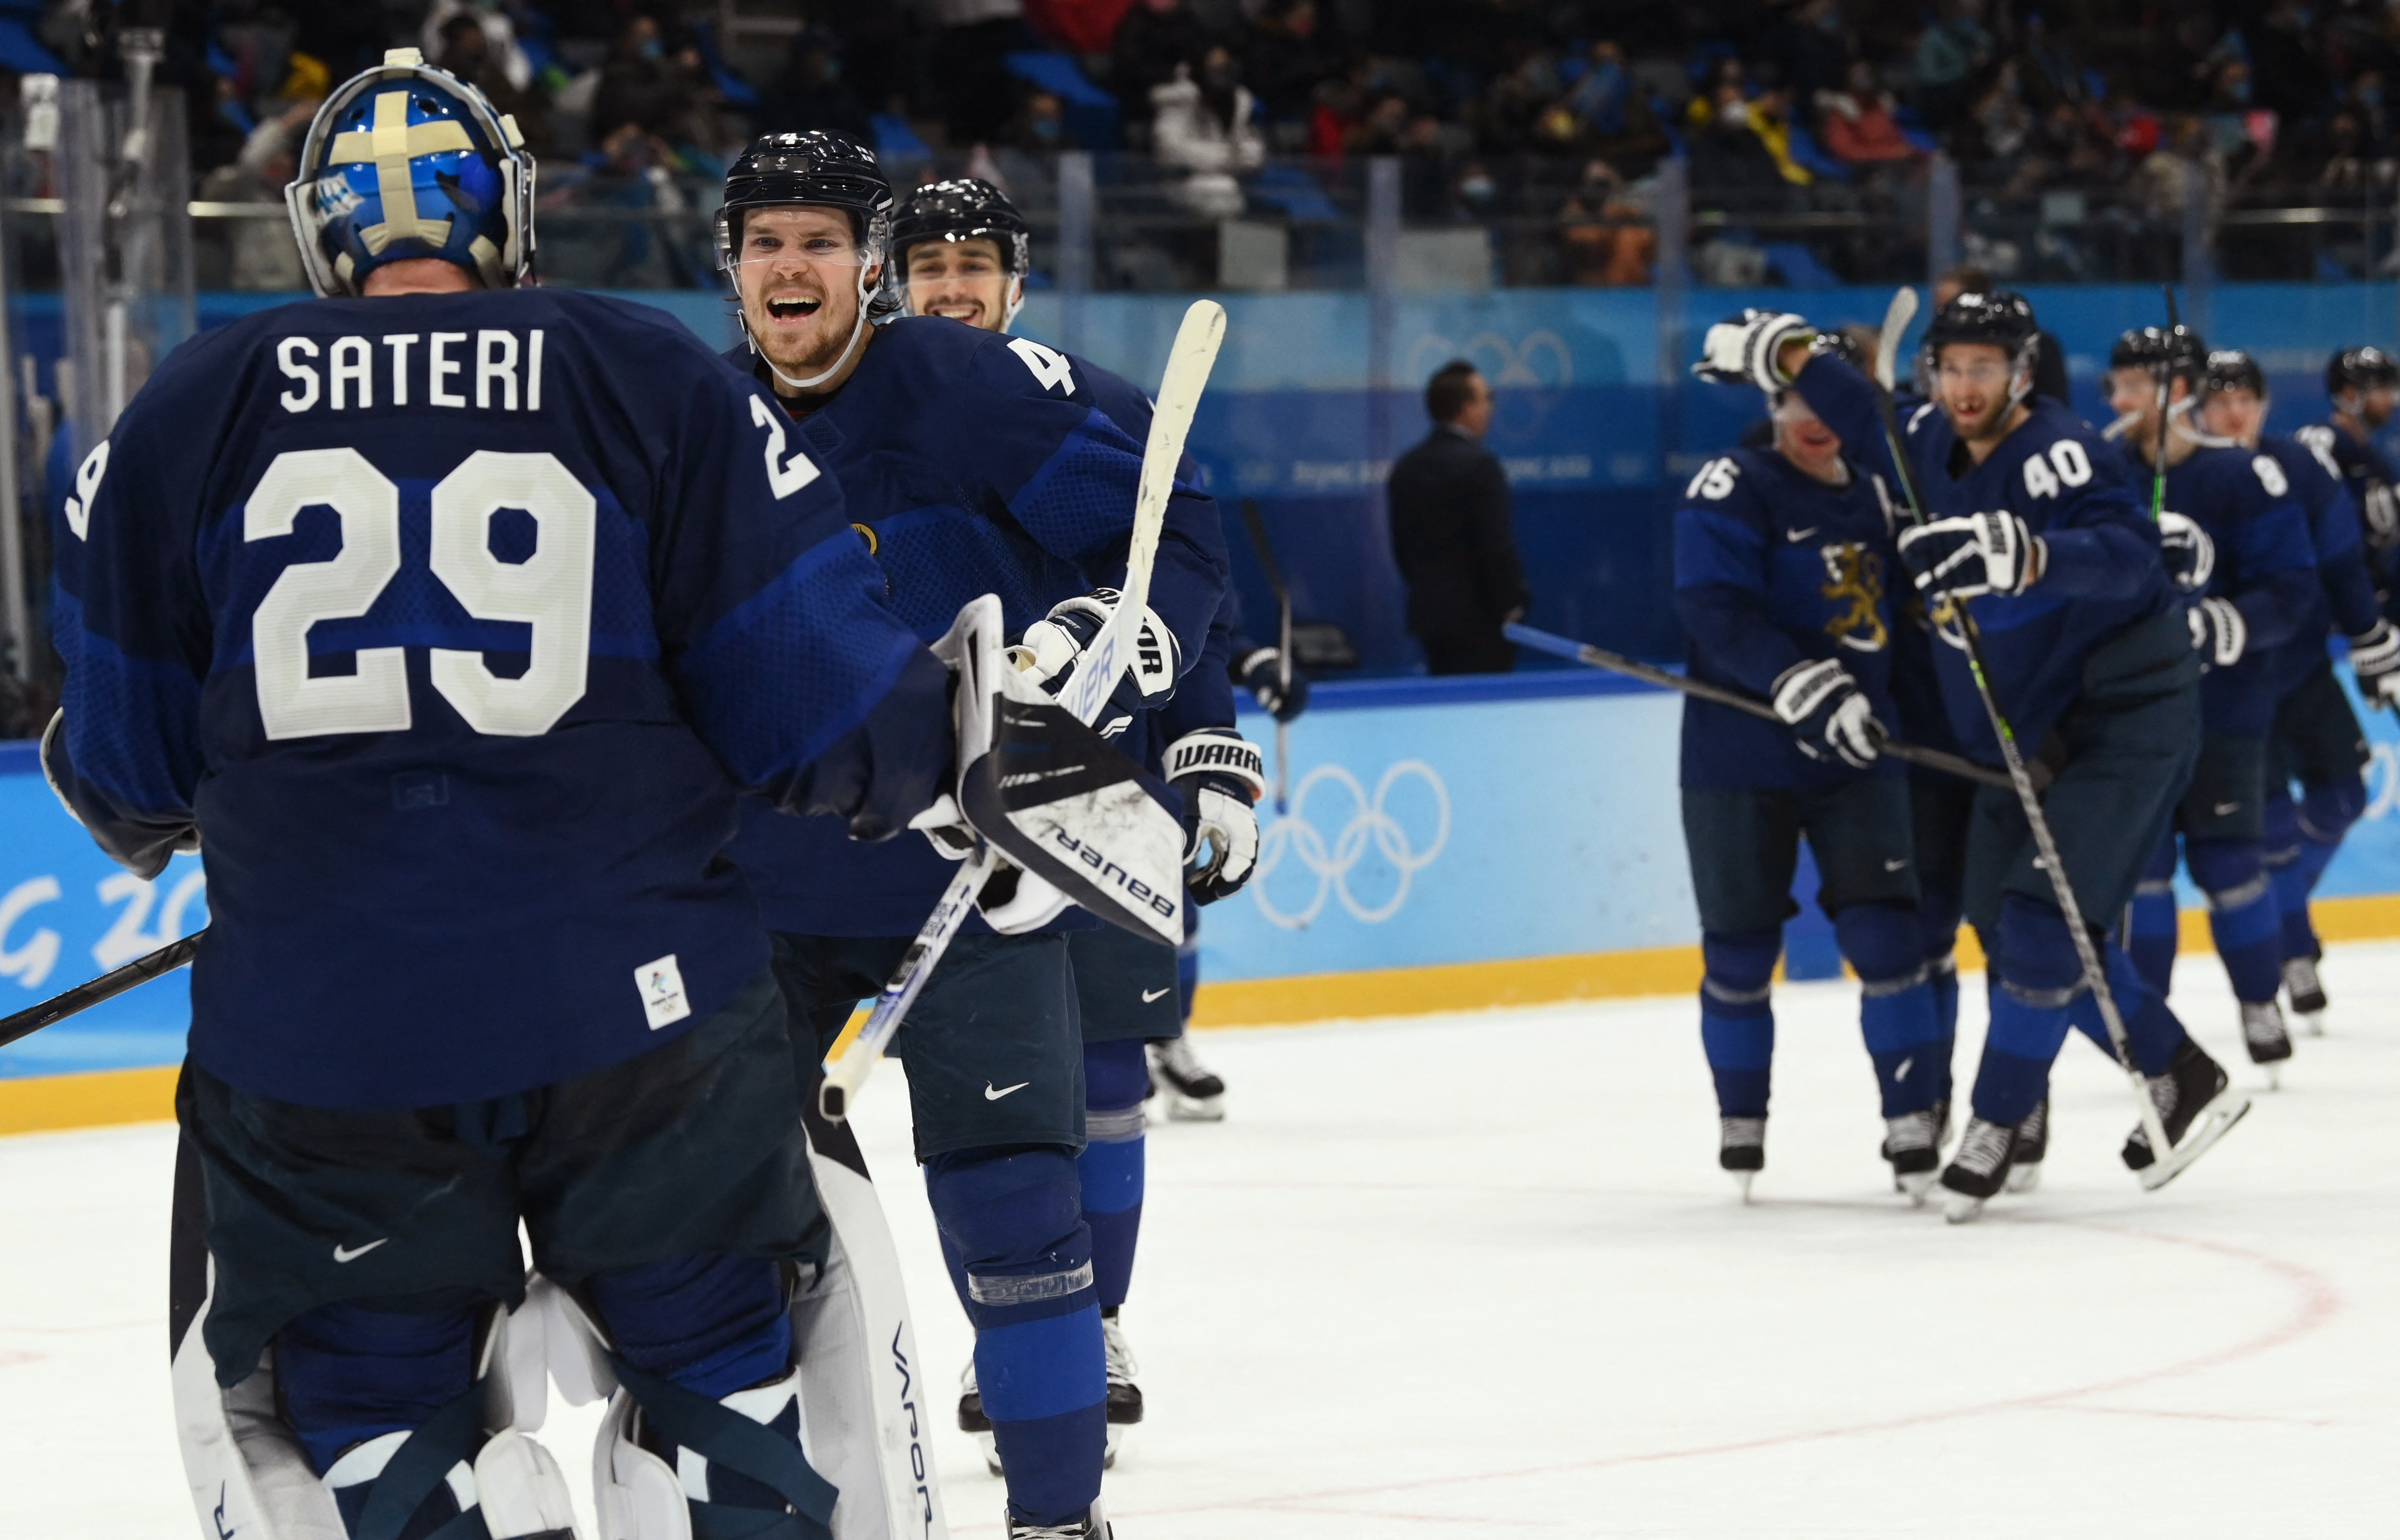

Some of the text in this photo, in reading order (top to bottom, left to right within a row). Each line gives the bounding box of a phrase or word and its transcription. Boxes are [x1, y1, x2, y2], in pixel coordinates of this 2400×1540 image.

[779, 133, 797, 144] 4
[277, 329, 544, 413] SATERI
[1006, 337, 1076, 397] 4
[749, 393, 822, 501] 2
[1685, 457, 1740, 500] 15
[2023, 438, 2093, 496] 40
[244, 447, 597, 741] 29
[1056, 826, 1175, 918] BAUER
[892, 1319, 932, 1540] VAPOR
